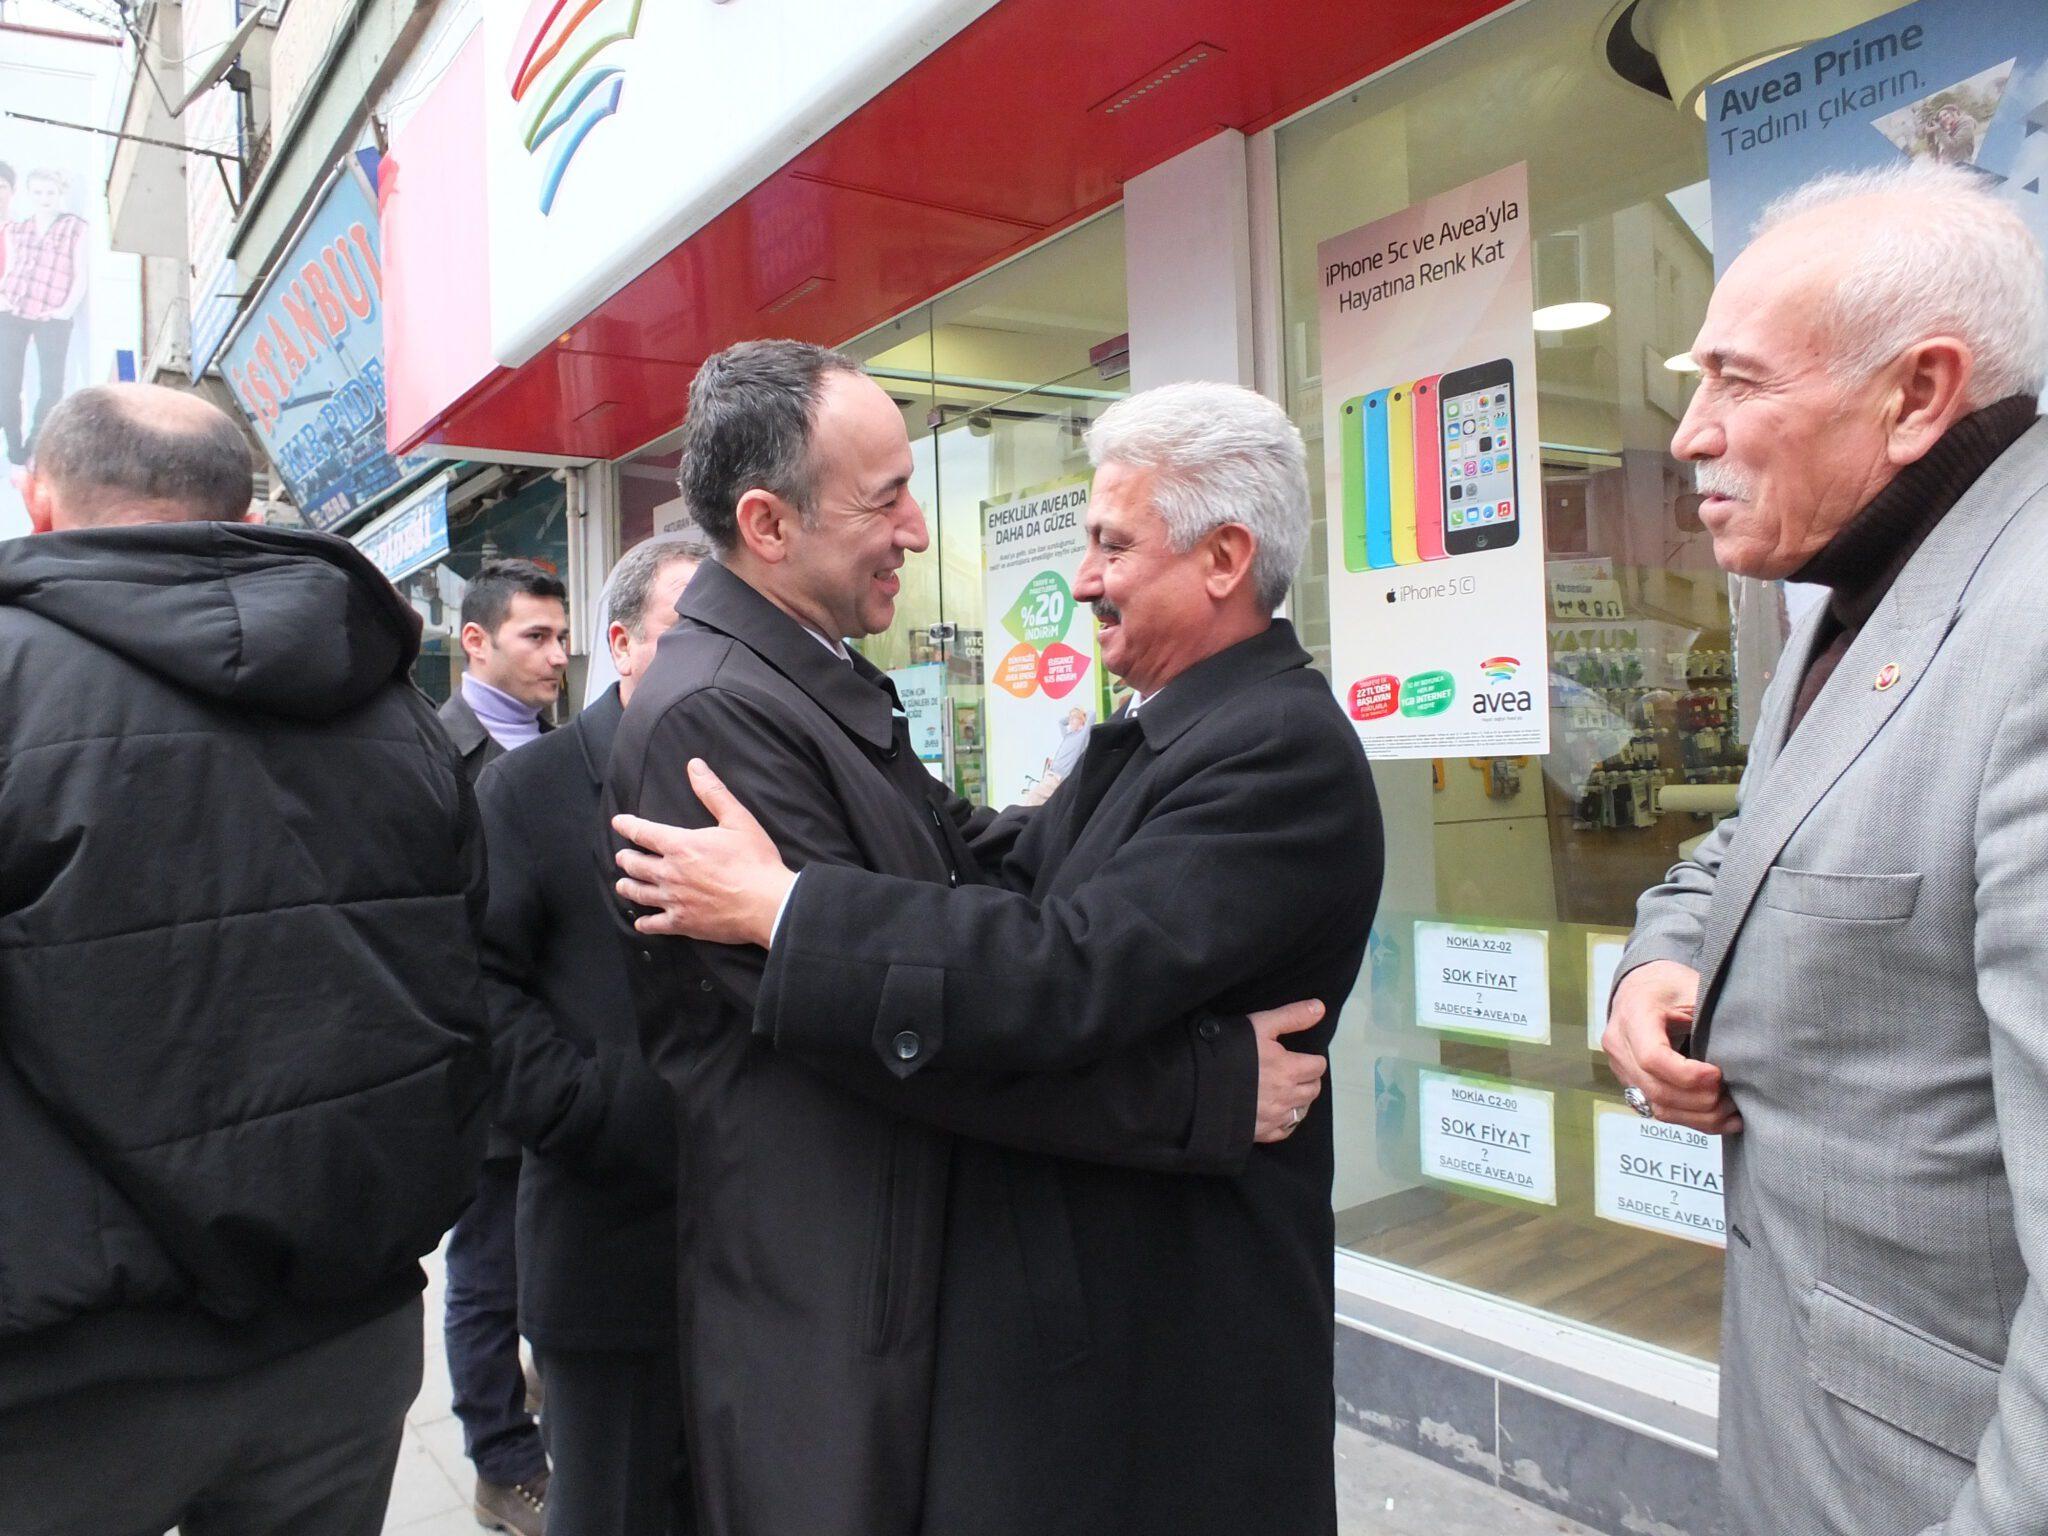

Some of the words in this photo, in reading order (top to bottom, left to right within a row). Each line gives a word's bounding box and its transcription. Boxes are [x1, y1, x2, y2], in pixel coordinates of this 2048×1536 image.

[1719, 69, 1802, 121] Avea
[1814, 23, 1925, 86] Prime
[1721, 106, 1807, 156] Tadını
[1818, 69, 1927, 129] çıkarın.
[1325, 251, 1383, 287] iPhone
[1388, 241, 1408, 264] 5c
[1412, 232, 1435, 254] ve
[1439, 199, 1519, 247] Avea'yla
[1339, 272, 1415, 313] Hayatına
[1420, 253, 1466, 286] Renk
[1471, 239, 1505, 269] Kat
[1041, 488, 1087, 516] AVEA'DA
[995, 527, 1025, 545] DAHA
[1026, 521, 1041, 537] DA
[1043, 512, 1077, 533] GÜZEL
[1399, 581, 1446, 602] iPhone
[1020, 590, 1064, 628] %20
[1472, 690, 1532, 714] avea
[1446, 935, 1480, 949] NOKİA
[1482, 939, 1512, 952] X2-02
[1476, 968, 1518, 989] FİYAT
[1434, 1001, 1473, 1016] SADECE
[1483, 1009, 1528, 1023] AVEA'DA
[1451, 1087, 1485, 1103] NOKİA
[1488, 1095, 1518, 1110] C2-00
[1481, 1123, 1531, 1150] FİYAT
[1640, 1123, 1682, 1141] NOKİA
[1686, 1132, 1709, 1147] 306
[1439, 1154, 1482, 1175] SADECE
[1485, 1166, 1534, 1186] AVEA'DA
[1619, 1153, 1664, 1179] ŞOK
[1617, 1196, 1671, 1219] SADECE
